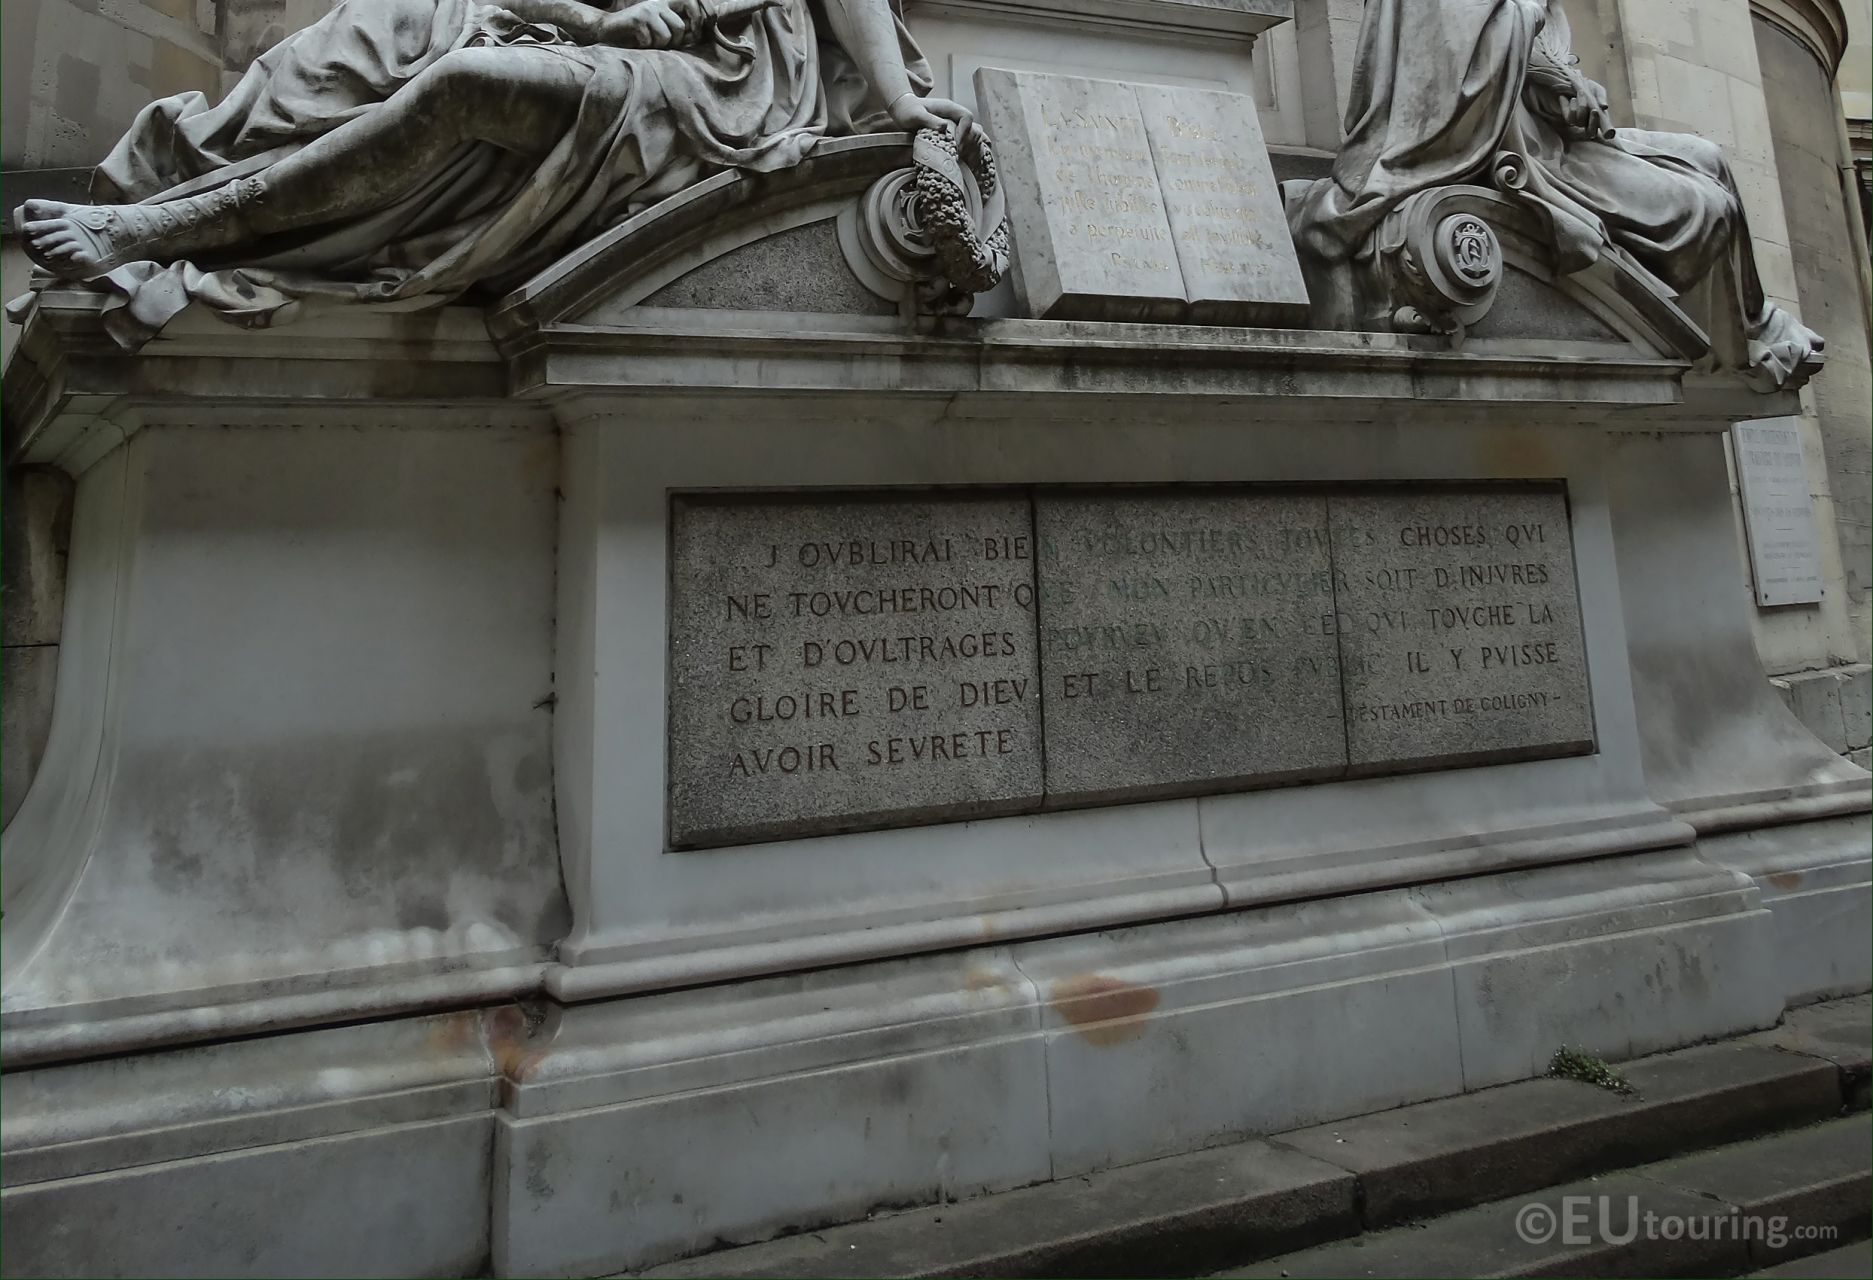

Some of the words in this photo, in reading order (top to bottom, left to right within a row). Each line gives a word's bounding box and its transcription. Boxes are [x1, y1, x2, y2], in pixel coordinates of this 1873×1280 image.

[798, 538, 951, 568] OVBLIRAI
[1400, 525, 1486, 547] CHOSES
[1506, 523, 1545, 549] QVI
[727, 594, 772, 620] NE
[790, 585, 999, 618] TOVCHERONT
[728, 644, 771, 672] ET
[803, 631, 1016, 669] D'OVLTRAGES
[1426, 604, 1514, 630] TOVCHE
[1528, 603, 1554, 625] LA
[730, 689, 861, 724] GLOIRE
[888, 685, 928, 713] DE
[960, 679, 1029, 708] DIEV
[1062, 672, 1099, 698] ET
[1126, 668, 1161, 694] LE
[1407, 651, 1430, 674] IL
[1450, 648, 1465, 670] Y
[1481, 642, 1559, 669] PVISSE
[1453, 697, 1474, 714] DE
[729, 743, 840, 778] AVOIR
[867, 730, 1013, 766] SEVRETE
